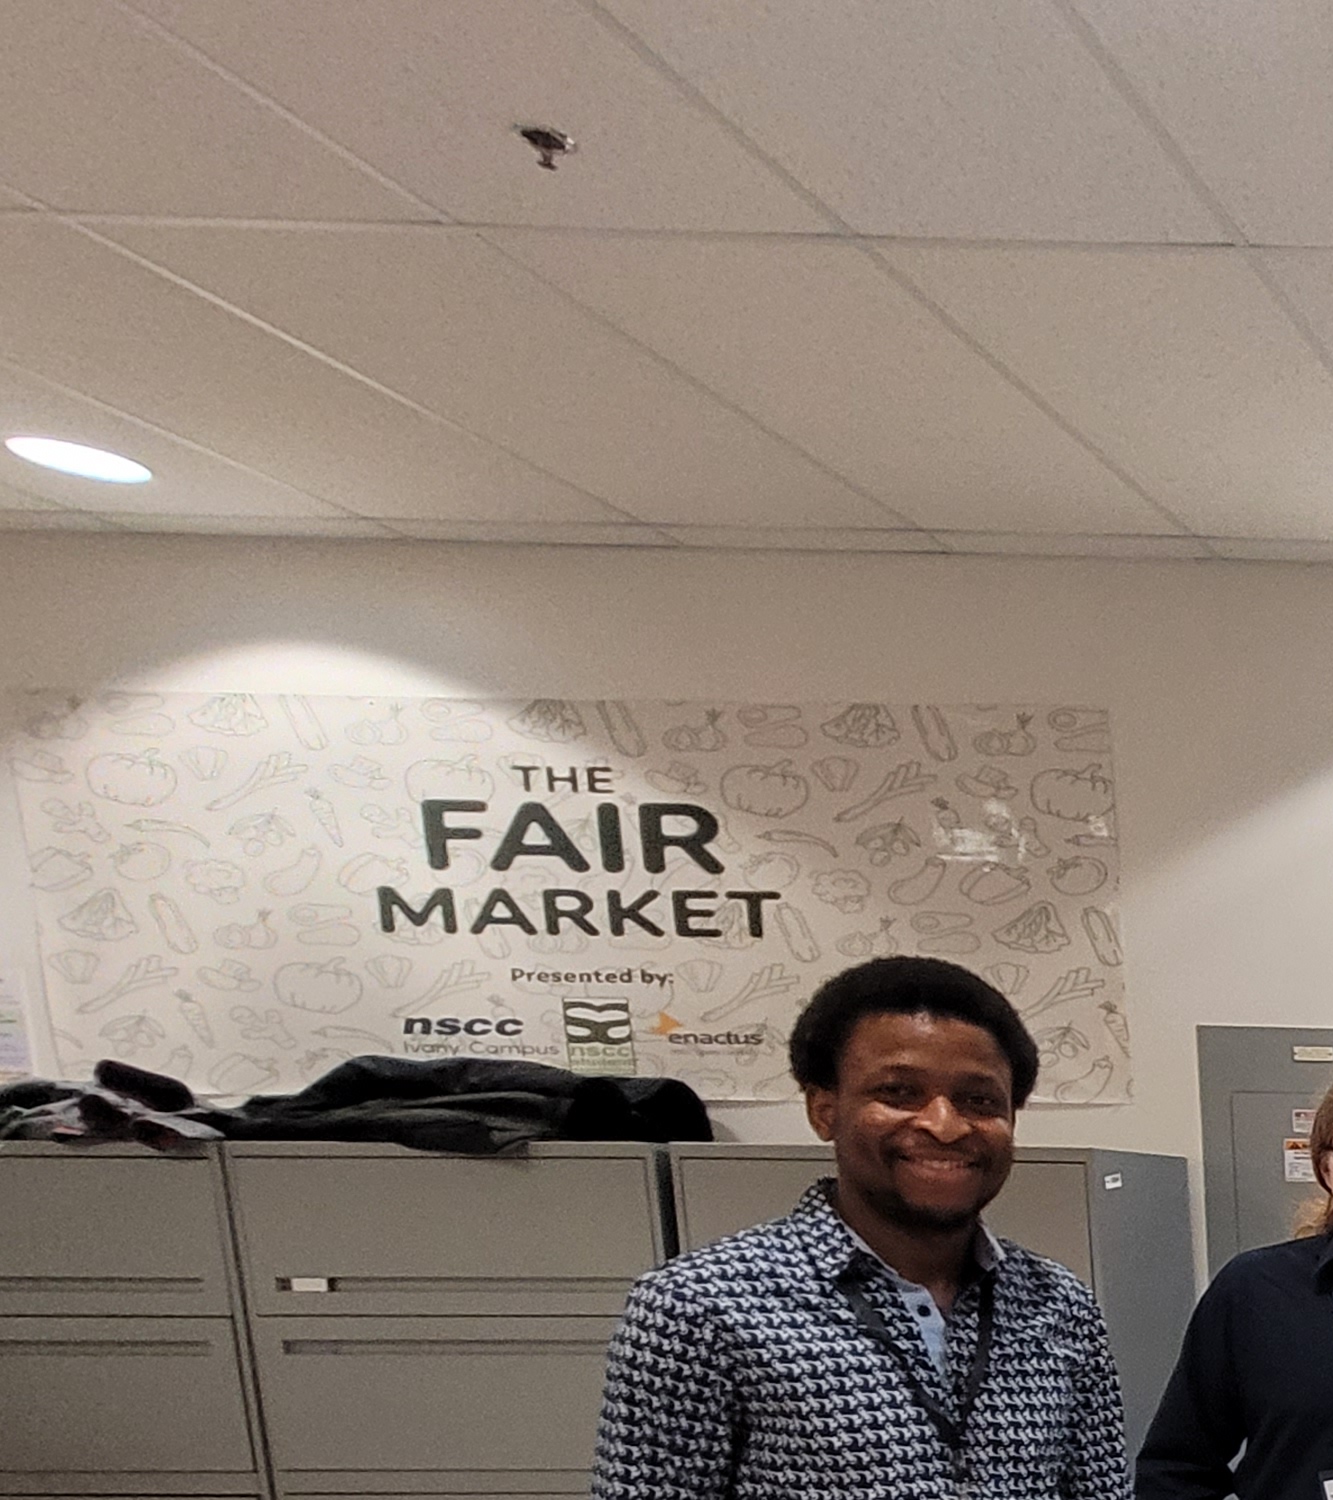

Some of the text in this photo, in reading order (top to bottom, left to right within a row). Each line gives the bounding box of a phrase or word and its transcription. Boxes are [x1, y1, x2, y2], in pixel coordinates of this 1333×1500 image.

[511, 765, 615, 794] THE
[420, 799, 725, 875] FAIR
[376, 885, 782, 939] MARKET
[510, 967, 675, 990] Presented by:
[402, 1015, 524, 1037] nscc
[468, 1039, 560, 1058] Campus
[668, 1030, 764, 1046] enactus
